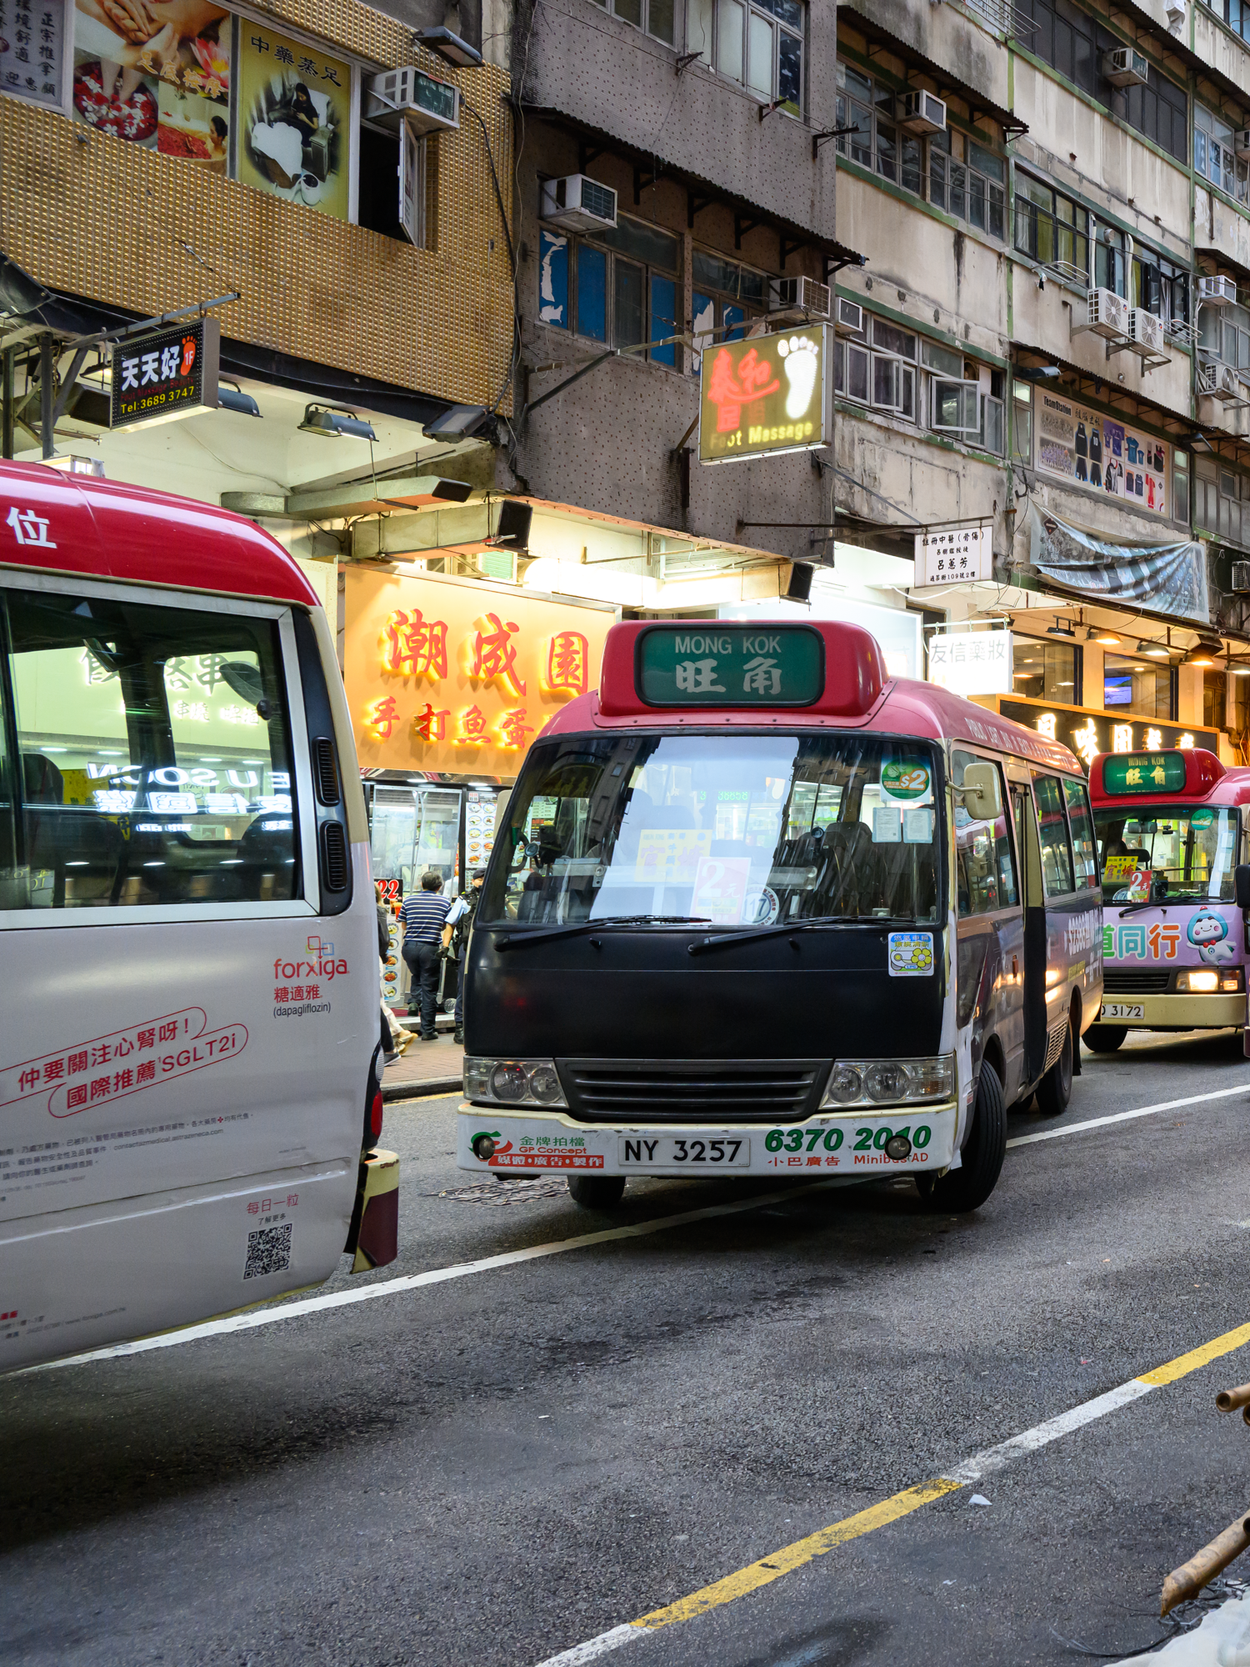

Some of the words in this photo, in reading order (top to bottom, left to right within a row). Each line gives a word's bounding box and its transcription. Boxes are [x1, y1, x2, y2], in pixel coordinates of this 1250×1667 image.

[251, 36, 342, 87] 中藥蒸足
[137, 51, 229, 98] 足底按摩
[121, 345, 180, 392] 天天好
[185, 351, 194, 365] 1F
[121, 393, 166, 414] Tel:3689
[168, 386, 195, 402] 3747
[6, 506, 57, 549] 位
[675, 636, 732, 654] MONG
[743, 636, 781, 653] KOK
[676, 656, 782, 695] 旺角
[371, 696, 535, 749] 手打魚蛋
[1128, 757, 1149, 766] MONG
[1151, 757, 1166, 765] KOK
[901, 769, 926, 788] $2
[1125, 765, 1166, 786] 旺角
[273, 956, 350, 981] forxiga
[1111, 1005, 1141, 1017] 3172
[520, 1136, 585, 1147] 金牌拍檔
[537, 1146, 587, 1155] Concept
[625, 1140, 658, 1162] NY
[673, 1140, 742, 1162] 3257
[765, 1128, 844, 1152] 6370
[911, 1152, 929, 1163] AD
[246, 1193, 299, 1215] 每日一粒
